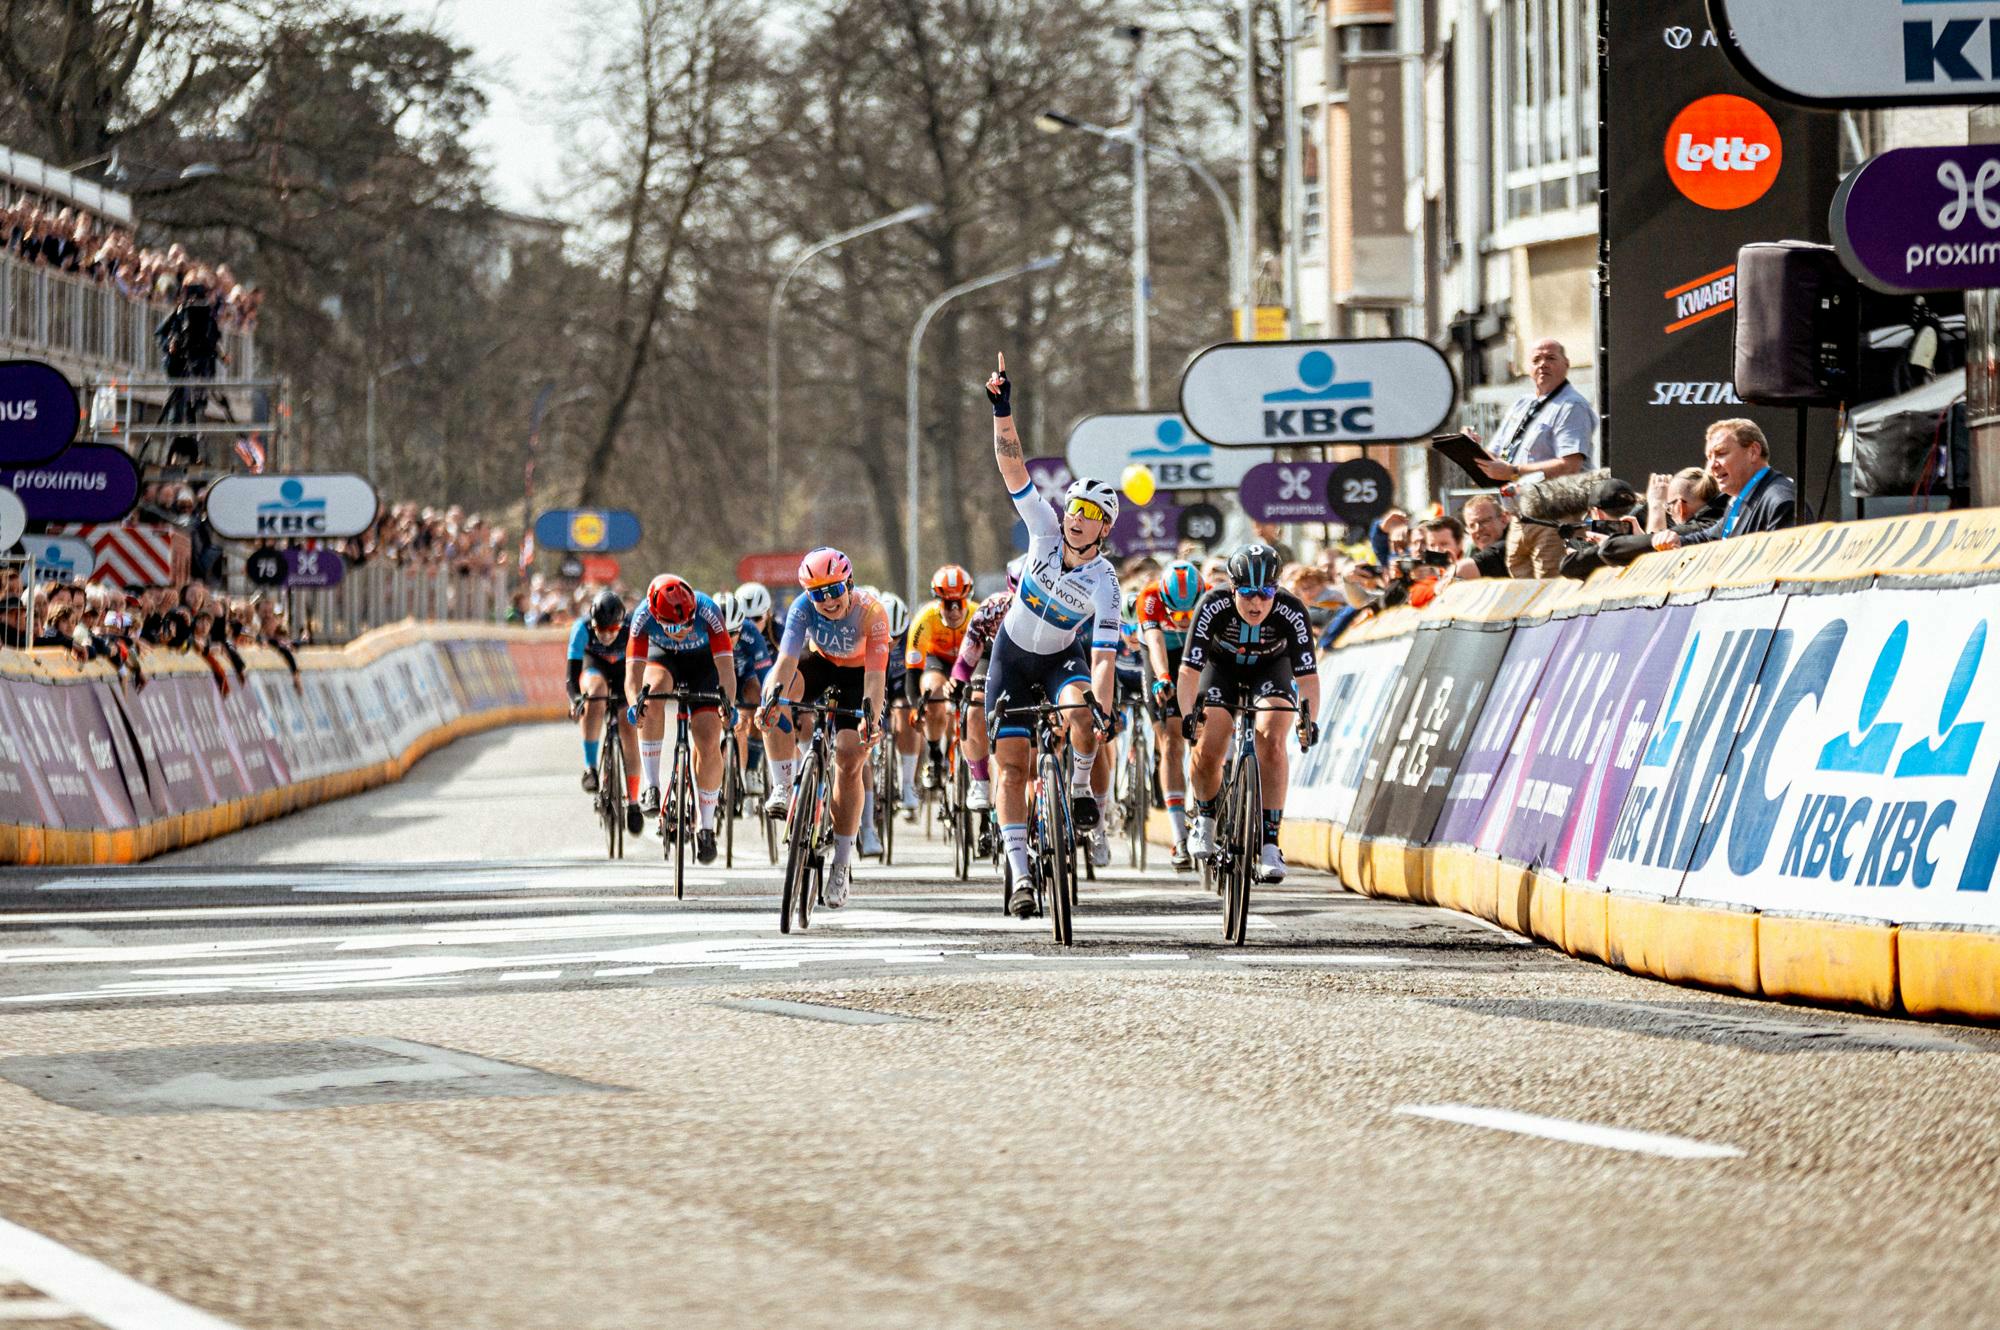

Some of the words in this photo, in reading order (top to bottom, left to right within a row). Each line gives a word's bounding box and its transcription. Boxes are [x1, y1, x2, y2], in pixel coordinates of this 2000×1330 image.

[1903, 18, 2000, 83] K
[1264, 406, 1374, 439] KBC
[13, 470, 107, 493] proximus
[1342, 480, 1379, 504] 25
[1264, 504, 1326, 517] proximus
[257, 515, 326, 535] KBC
[1055, 586, 1085, 609] worx
[816, 630, 854, 651] UAE
[1641, 618, 1848, 876] KBC
[1608, 786, 1658, 863] KBC
[1779, 793, 1873, 882] KBC
[1854, 799, 1957, 889] KBC
